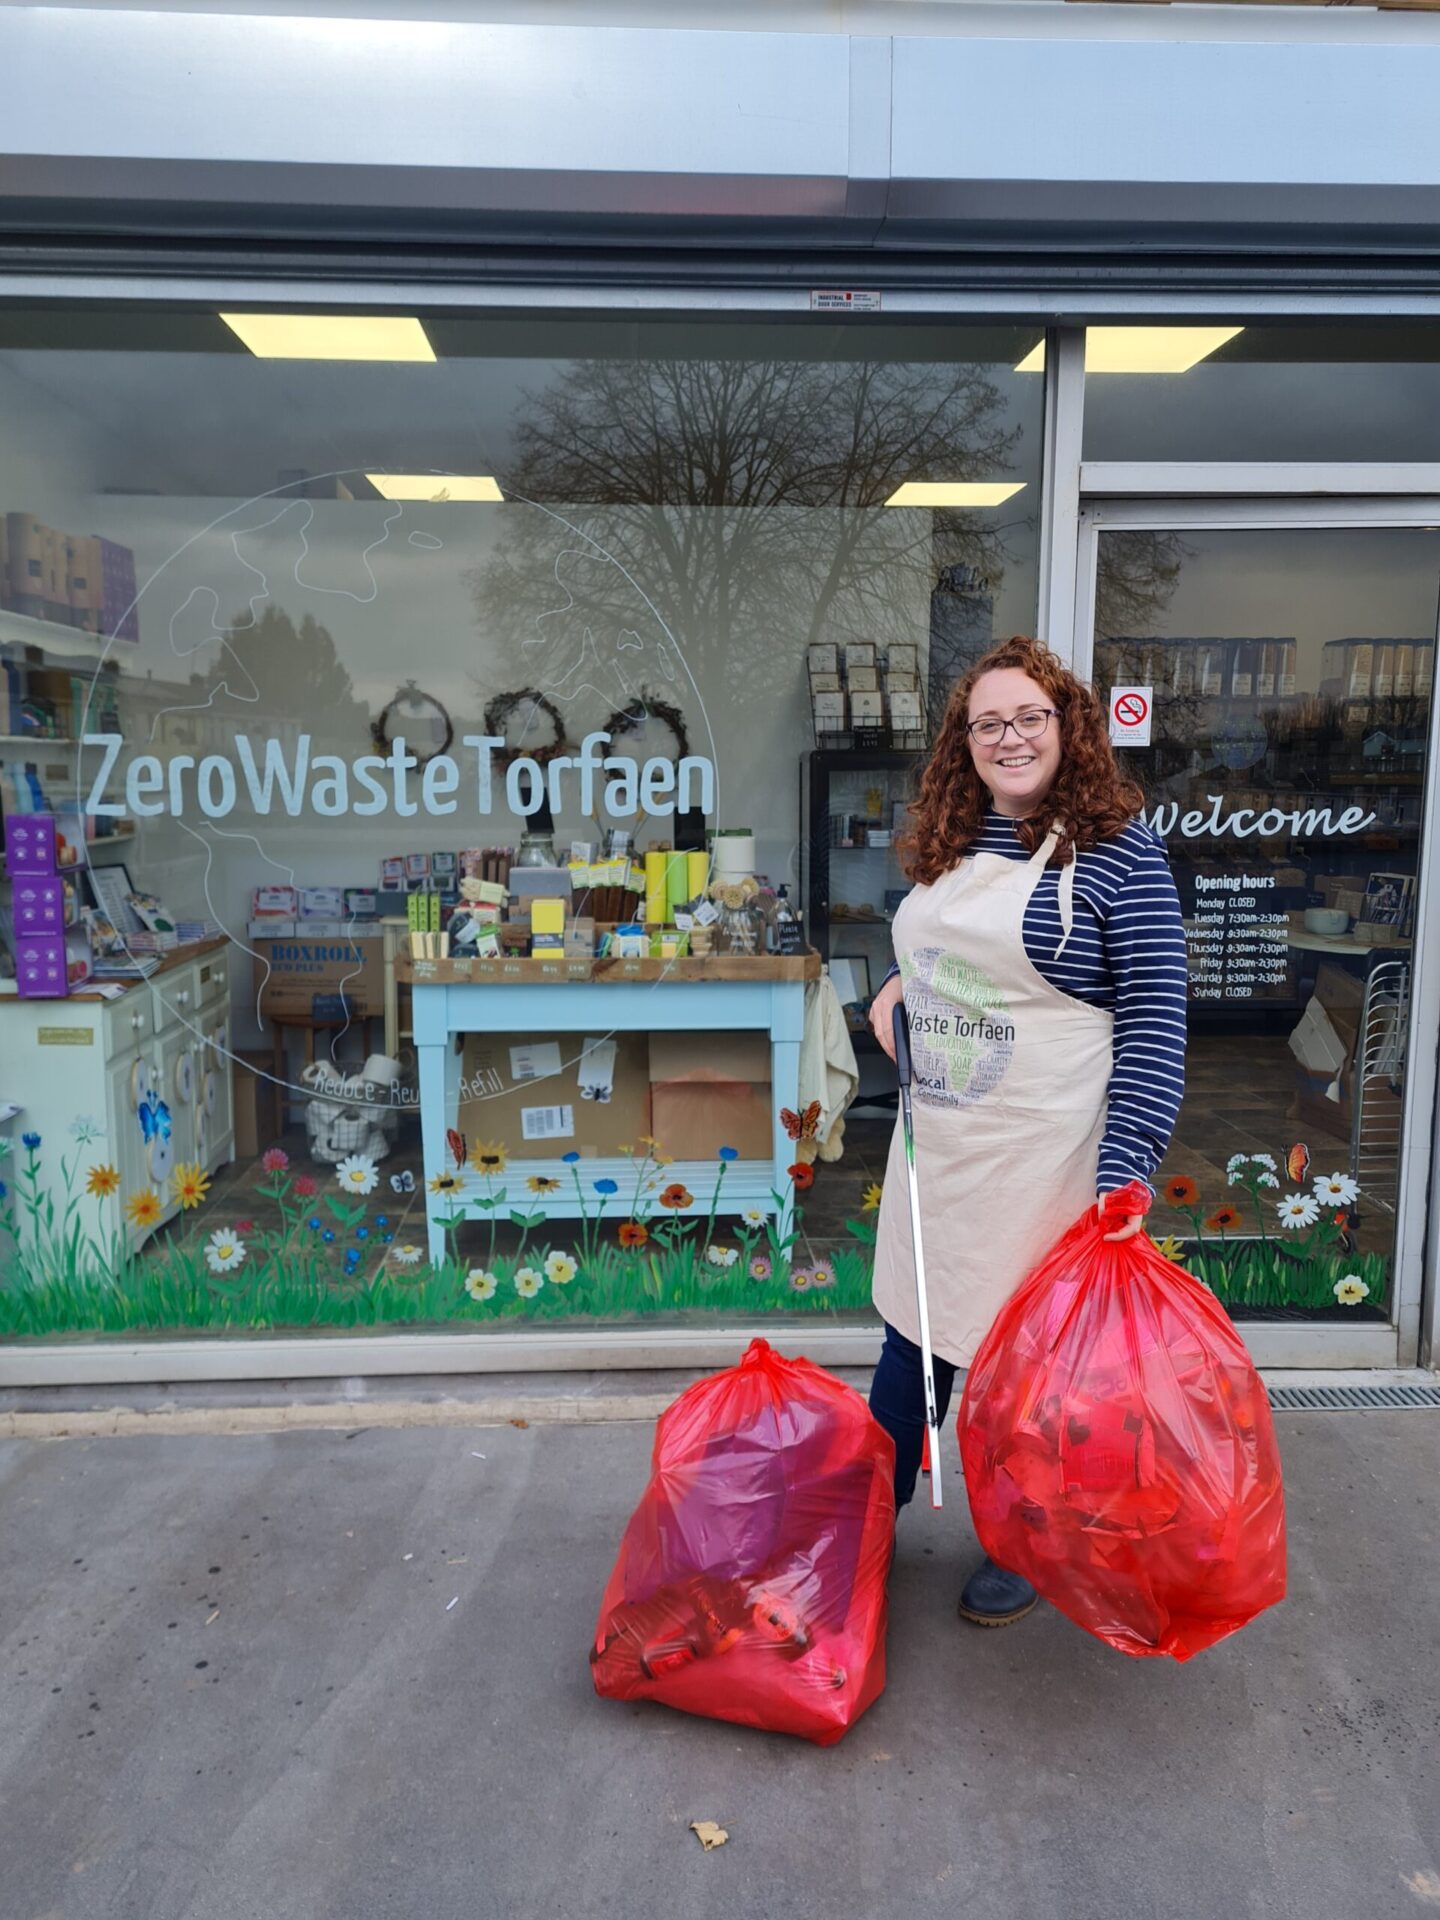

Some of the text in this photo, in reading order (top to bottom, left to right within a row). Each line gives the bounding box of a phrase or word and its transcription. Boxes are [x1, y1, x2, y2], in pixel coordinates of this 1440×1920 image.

[1140, 794, 1377, 838] Welcome
[1195, 873, 1275, 893] Opening hours
[1196, 897, 1256, 910] Monday CLOSED
[1193, 912, 1225, 925] Tuesday
[271, 944, 368, 963] BOXROLL
[1188, 942, 1224, 955] Thursday
[939, 963, 956, 979] ZERO
[956, 966, 978, 983] WASTE
[1200, 957, 1223, 970] Friday
[1188, 972, 1223, 984] Saturday
[1193, 987, 1253, 999] Sunday CLOSED
[954, 1016, 1015, 1041] Torfaen
[952, 1054, 972, 1070] SOAP
[458, 1067, 504, 1101] Refill
[912, 1070, 946, 1090] Local
[917, 1087, 959, 1106] Community
